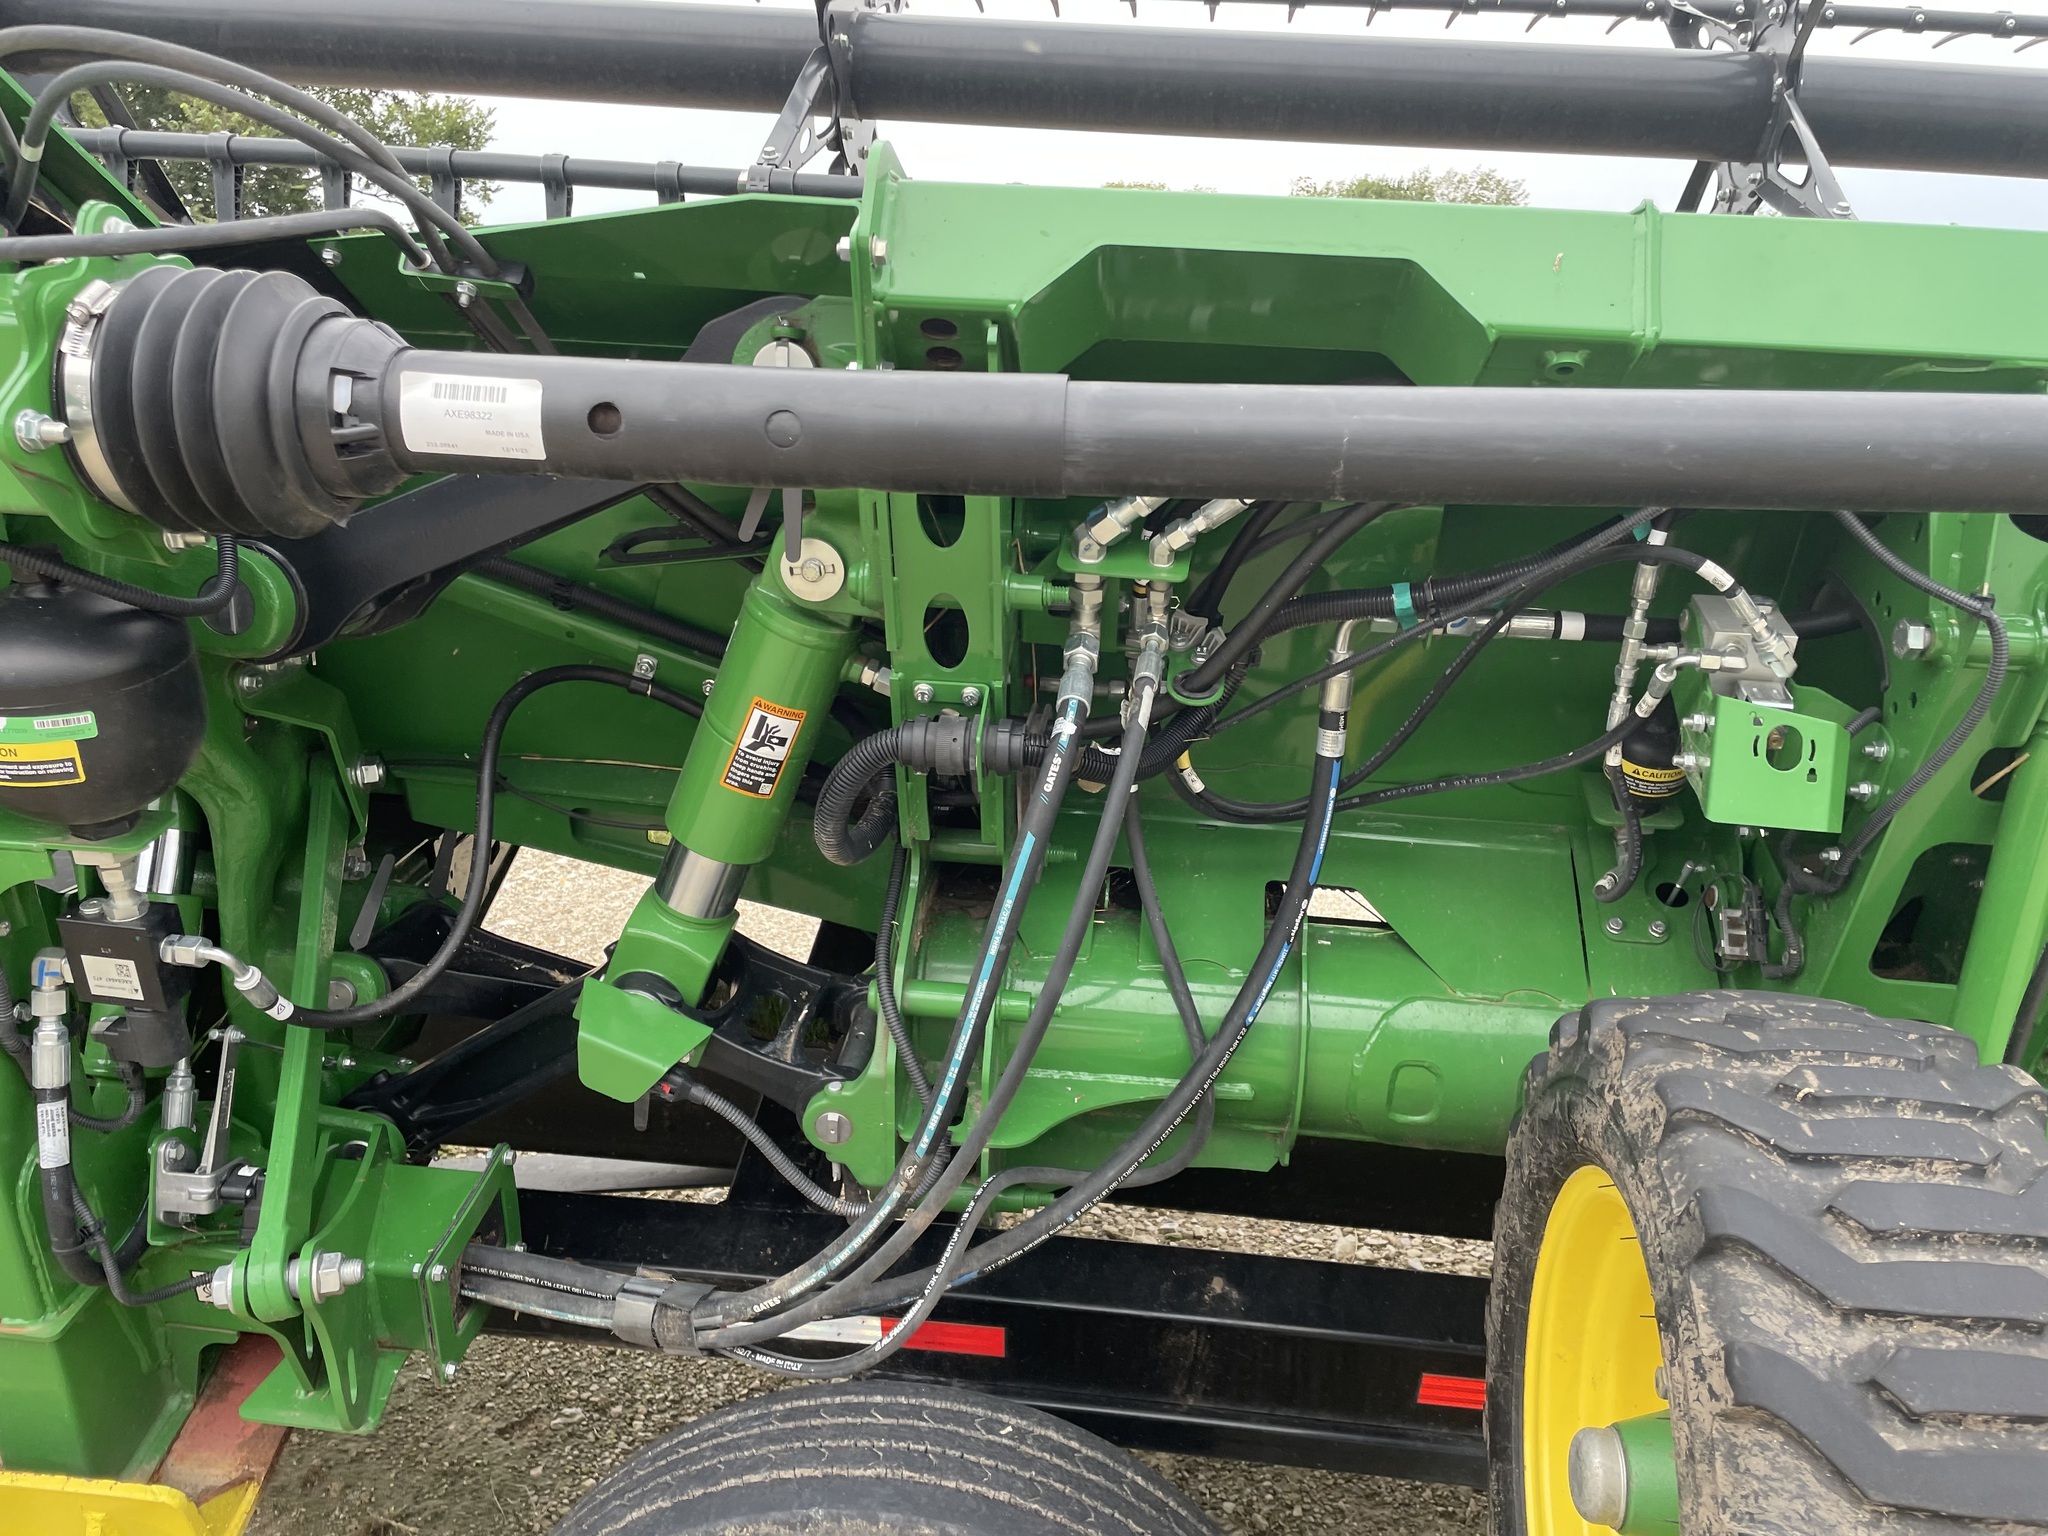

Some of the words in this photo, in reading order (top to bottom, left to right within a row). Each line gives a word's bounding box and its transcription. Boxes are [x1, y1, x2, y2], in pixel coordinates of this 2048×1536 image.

[444, 408, 493, 421] AXE98322
[485, 430, 504, 438] MADE
[763, 702, 804, 720] WARNING
[32, 762, 64, 770] exposure
[735, 755, 749, 765] from
[745, 752, 762, 763] avoid
[762, 758, 780, 768] injury
[730, 766, 750, 779] fingers
[750, 775, 765, 783] away
[732, 761, 746, 771] keep
[746, 768, 765, 777] hands
[1043, 756, 1062, 793] GATES
[1642, 770, 1683, 779] CAUTION
[728, 772, 742, 782] from
[741, 778, 753, 786] this
[989, 935, 1001, 956] MSHA
[1237, 1027, 1248, 1040] 22.5
[1230, 1039, 1240, 1052] MPa
[1218, 1050, 1232, 1069] (3250
[1209, 1067, 1221, 1080] PSI)
[1191, 1090, 1204, 1106] (15.9
[1180, 1104, 1193, 1118] mm)
[1174, 1116, 1183, 1126] ISO
[1160, 1124, 1176, 1142] 11237
[1138, 1152, 1149, 1164] SAE
[1108, 1180, 1120, 1190] ISO
[1092, 1188, 1110, 1204] 18752
[1080, 1202, 1093, 1214] Type
[1050, 1222, 1067, 1236] Flame
[1023, 1233, 1050, 1253] Resistant
[1006, 1250, 1024, 1262] MSHA
[880, 1298, 925, 1348] ALFAGOMMA
[923, 1274, 939, 1297] AT3K
[936, 1227, 962, 1275] SUPERTUFF
[752, 1297, 782, 1313] GATES
[756, 1353, 776, 1365] MADE
[776, 1359, 784, 1368] IN
[783, 1361, 803, 1372] ITALY
